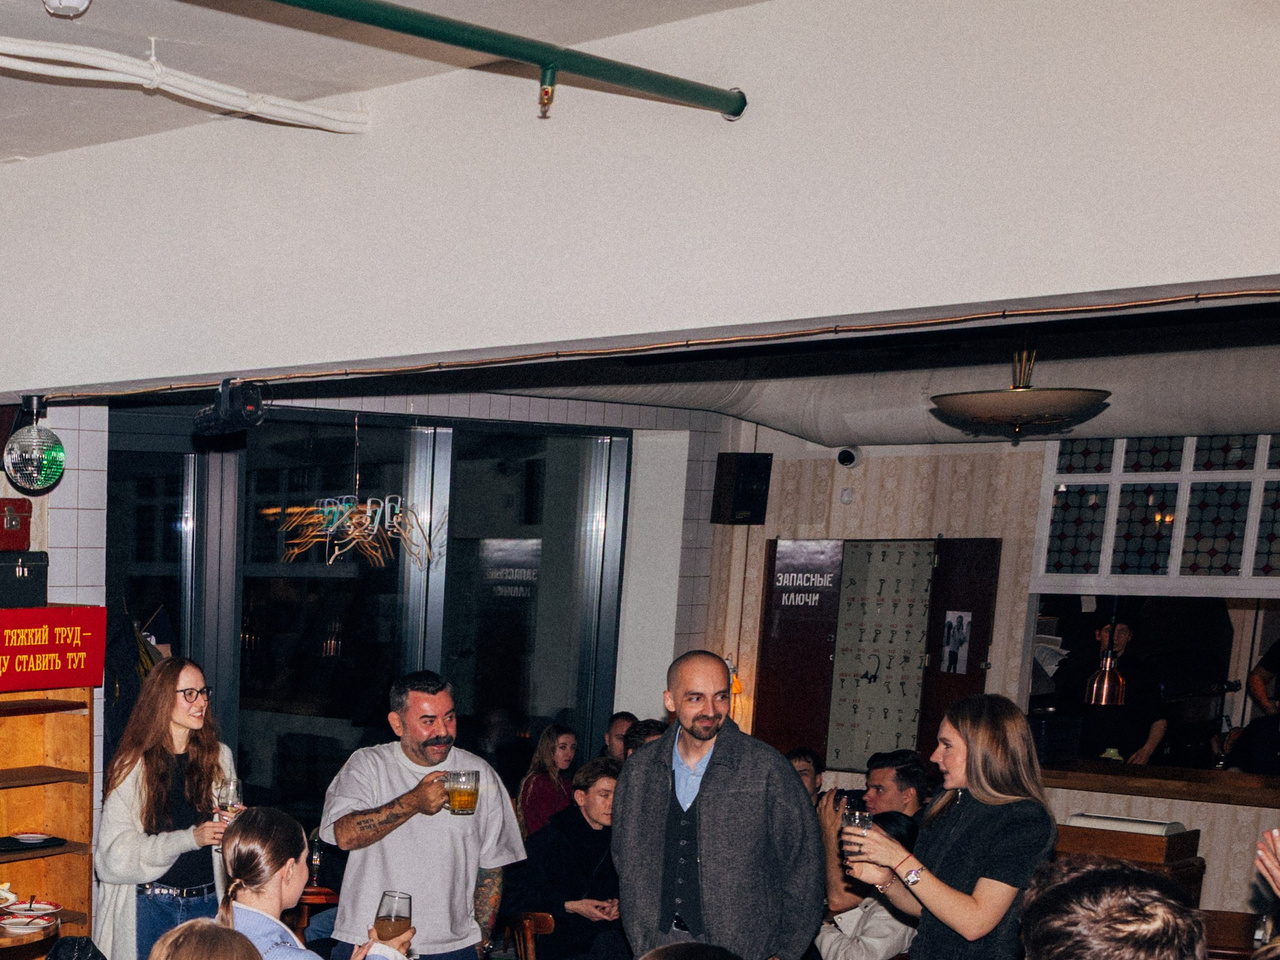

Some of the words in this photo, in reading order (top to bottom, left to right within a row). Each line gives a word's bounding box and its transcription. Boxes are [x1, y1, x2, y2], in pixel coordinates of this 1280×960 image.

[776, 572, 834, 587] ЗАПАСНЫЕ
[781, 592, 820, 606] КЛЮЧИ
[4, 625, 49, 647] ТЯЖКИЙ
[15, 653, 62, 672] СТАВИТЬ
[67, 652, 87, 670] ТУТ
